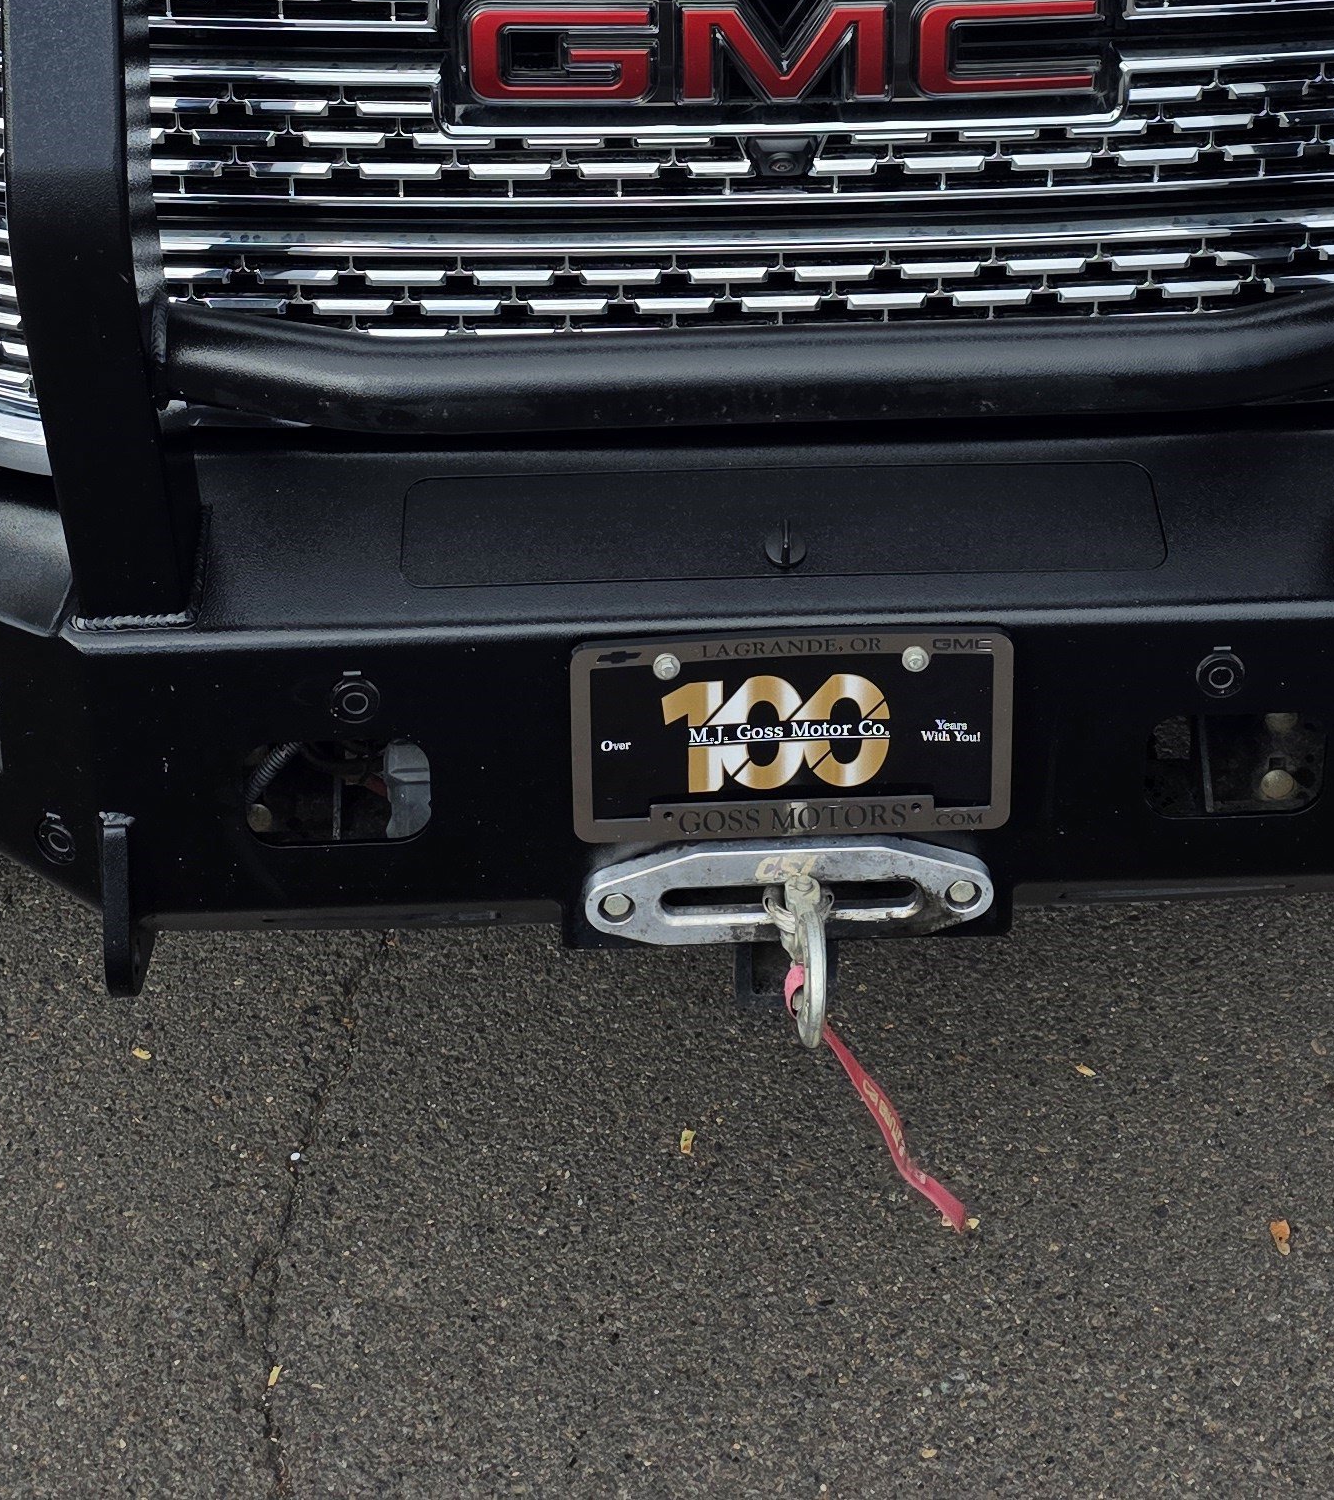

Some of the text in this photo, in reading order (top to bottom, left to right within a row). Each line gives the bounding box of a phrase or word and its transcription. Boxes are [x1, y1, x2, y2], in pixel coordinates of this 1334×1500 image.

[850, 637, 881, 652] OR
[932, 638, 992, 652] GMC
[736, 724, 784, 740] Goss
[791, 721, 852, 737] Motor
[858, 719, 890, 736] Co.
[934, 719, 968, 731] Years
[661, 673, 890, 793] 100
[921, 730, 981, 742] With You!
[600, 740, 632, 752] Over
[678, 808, 760, 834] GOSS
[771, 803, 906, 832] MOTORS
